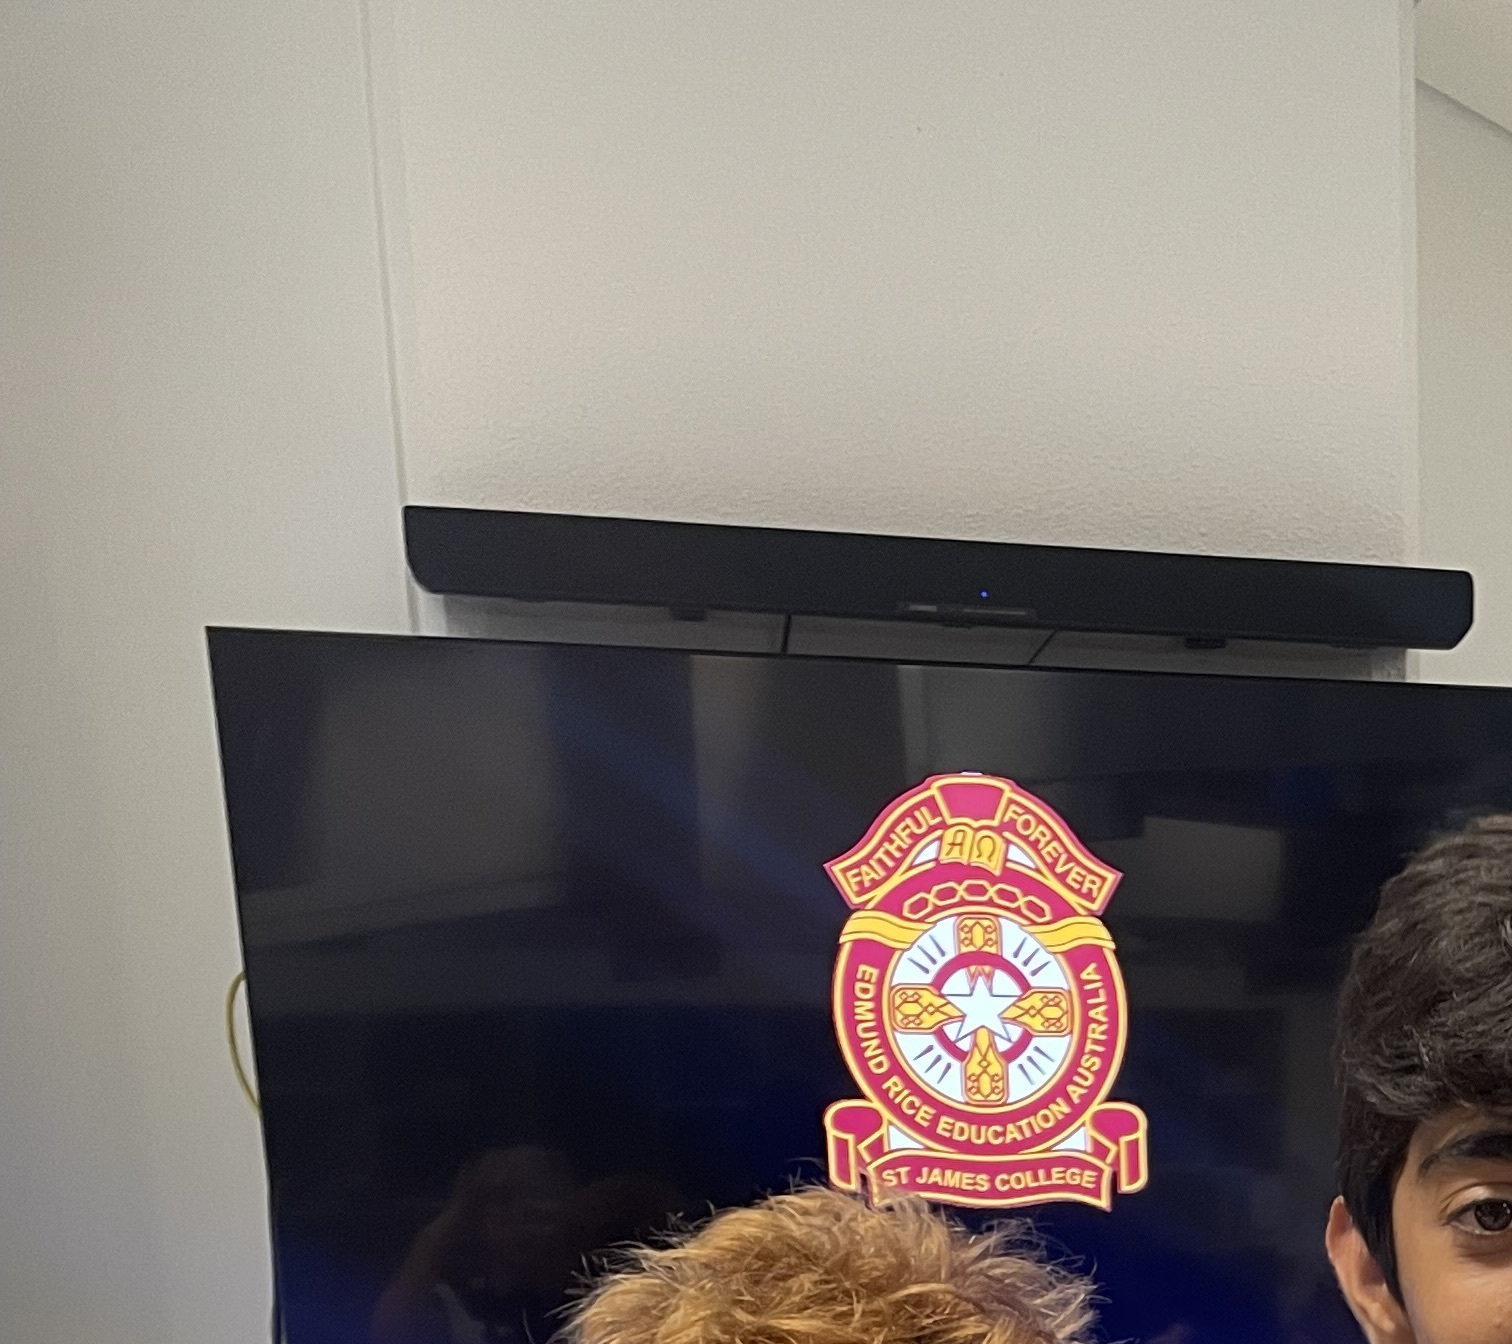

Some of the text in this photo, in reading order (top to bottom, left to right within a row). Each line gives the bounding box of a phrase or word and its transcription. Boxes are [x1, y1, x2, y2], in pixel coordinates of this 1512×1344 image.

[846, 806, 1102, 898] FAITHFUL FOREVER
[853, 963, 1108, 1145] EDMUND RICE EDUCATION AUSTRALIA
[881, 1166, 1098, 1191] ST JAMES COLLEGE
